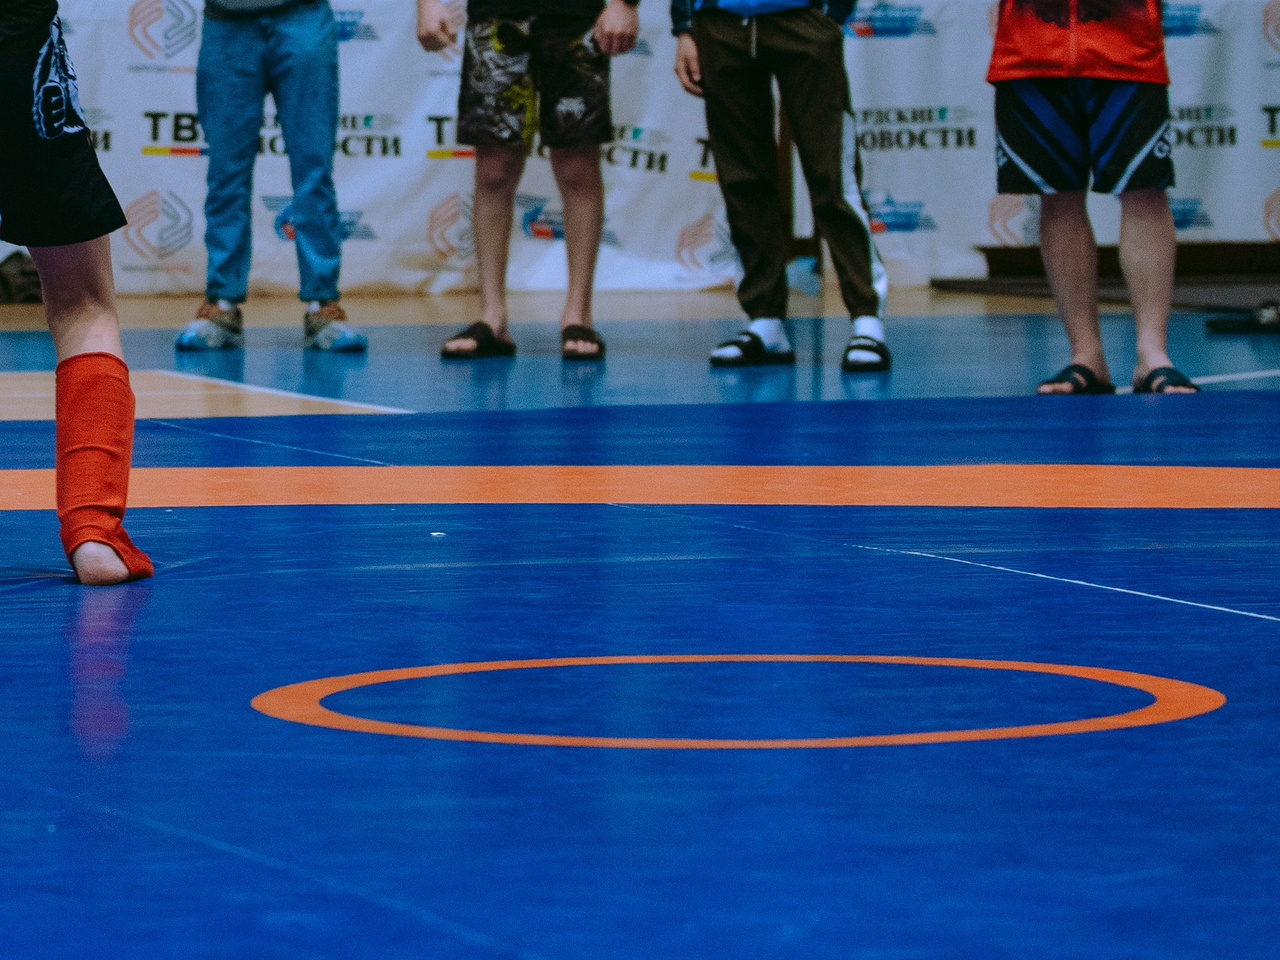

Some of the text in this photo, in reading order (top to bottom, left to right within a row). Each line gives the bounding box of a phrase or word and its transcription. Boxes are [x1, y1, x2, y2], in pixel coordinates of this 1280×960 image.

[143, 111, 198, 143] ТВ
[860, 107, 936, 125] РДСКИЕ
[858, 126, 977, 151] ОВОСТИ
